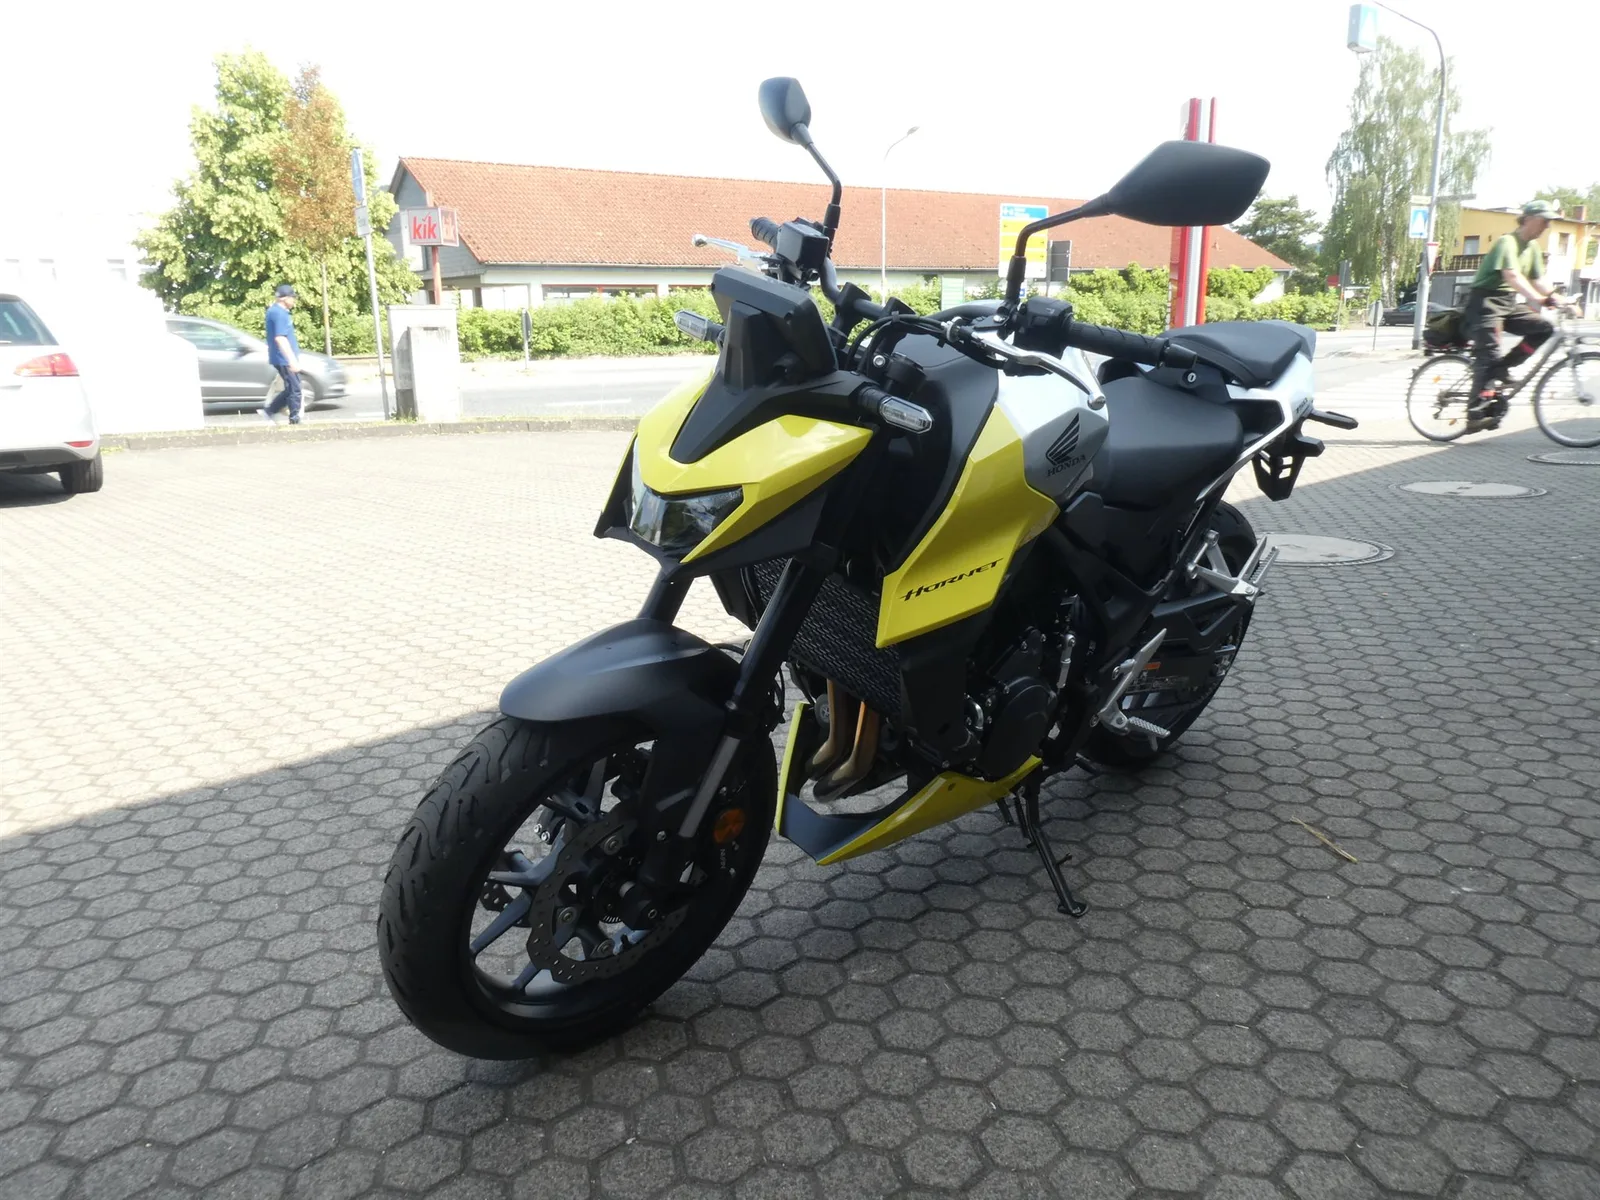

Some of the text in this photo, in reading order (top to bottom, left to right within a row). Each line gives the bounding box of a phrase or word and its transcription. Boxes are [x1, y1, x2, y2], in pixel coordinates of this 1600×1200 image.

[412, 212, 437, 239] kik
[1046, 454, 1086, 477] HONDA
[899, 558, 1003, 601] HORNET
